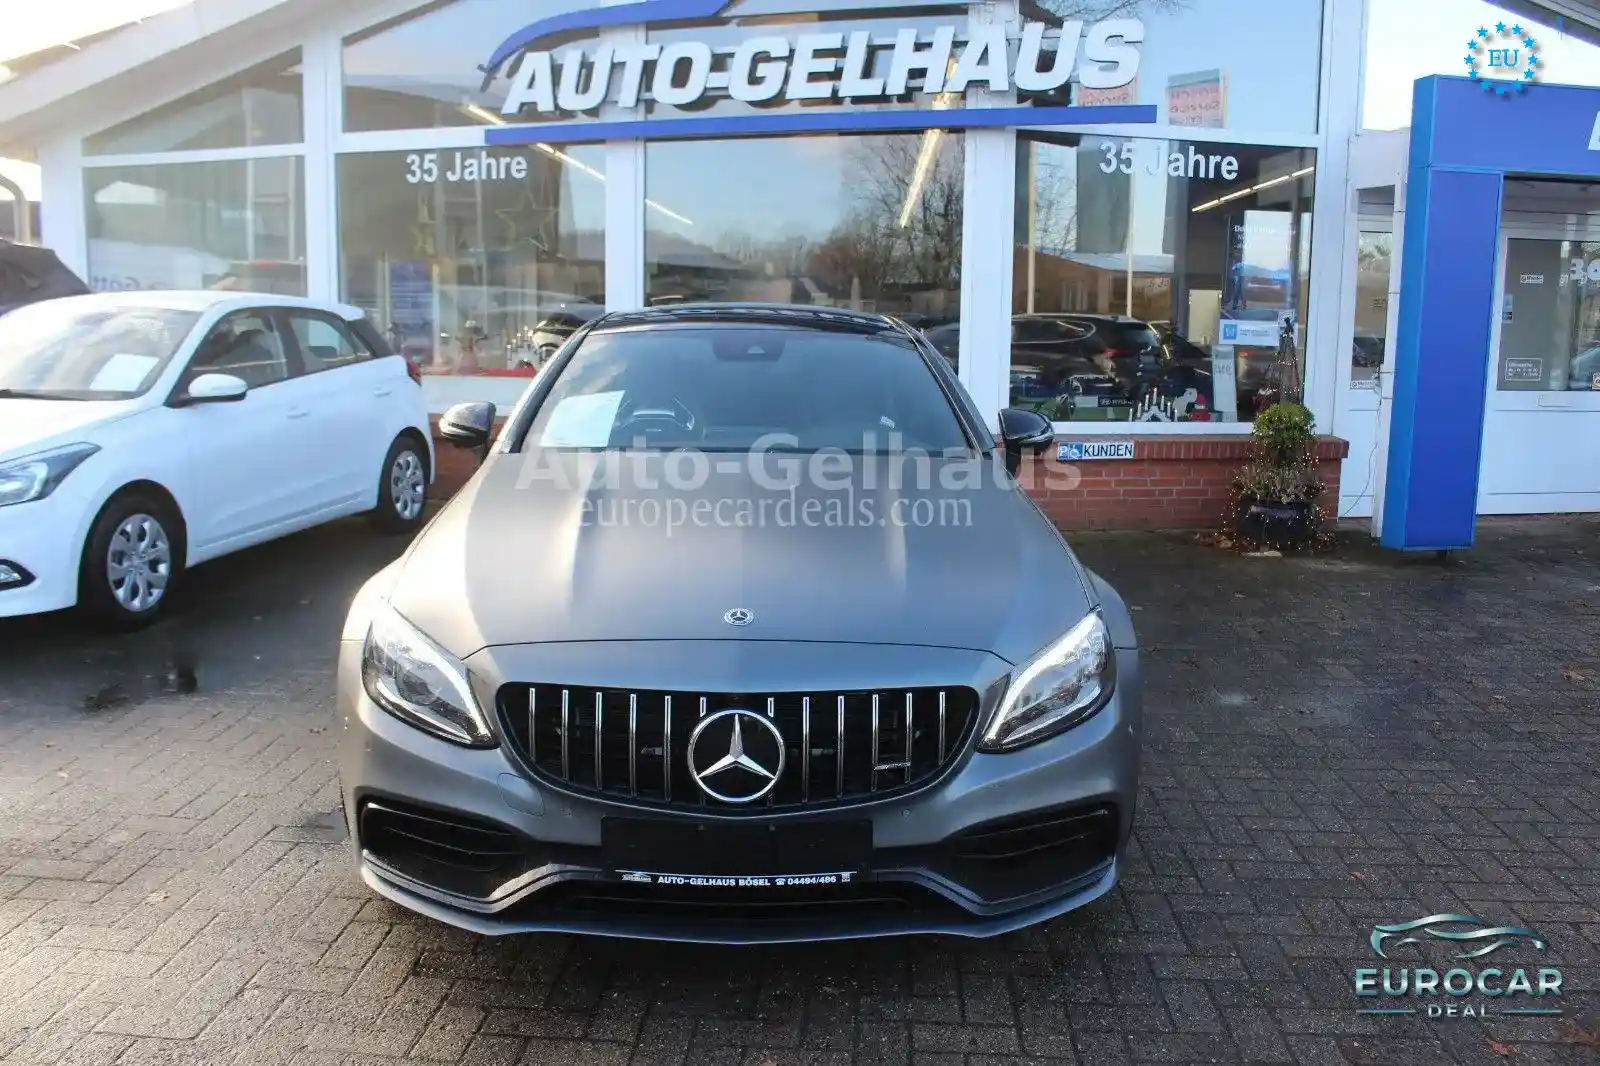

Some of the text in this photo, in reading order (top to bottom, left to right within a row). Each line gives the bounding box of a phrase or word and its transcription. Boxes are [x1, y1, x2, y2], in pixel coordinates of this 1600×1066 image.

[501, 18, 1144, 115] AUTO-GELHAUS
[405, 150, 527, 183] 35 Jahre
[1100, 140, 1239, 180] 35 Jahre
[1083, 444, 1133, 457] KUNDEN
[658, 876, 736, 886] AUTO-GELHAUS
[787, 876, 837, 886] 04494/486
